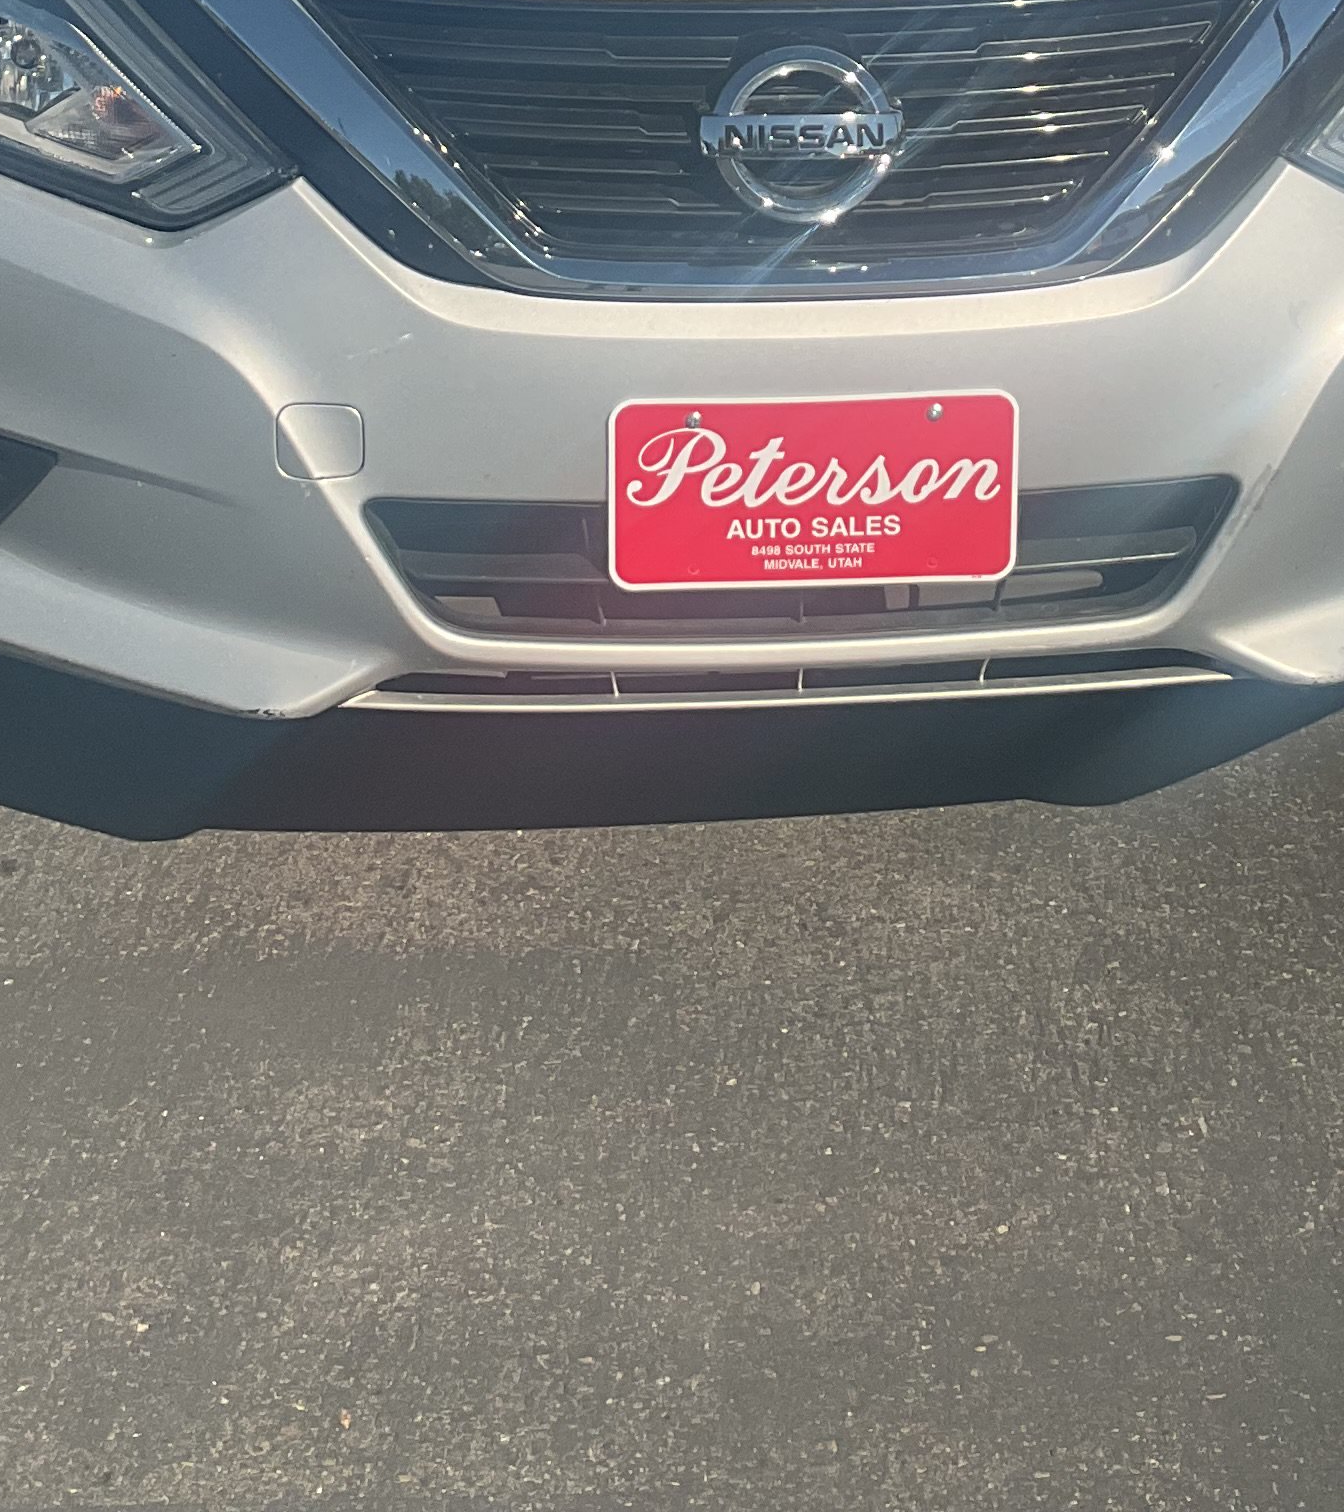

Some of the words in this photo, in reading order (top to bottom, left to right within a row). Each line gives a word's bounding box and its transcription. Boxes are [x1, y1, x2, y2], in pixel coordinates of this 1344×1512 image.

[719, 123, 884, 150] NISSAN
[626, 427, 1001, 508] Peterson
[726, 517, 801, 540] AUTO
[811, 515, 901, 538] SALES
[751, 545, 781, 556] 8498
[785, 543, 830, 555] SOUTH
[835, 542, 875, 554] STATE
[764, 558, 823, 570] MIDVALE,
[828, 557, 862, 568] UTAH
